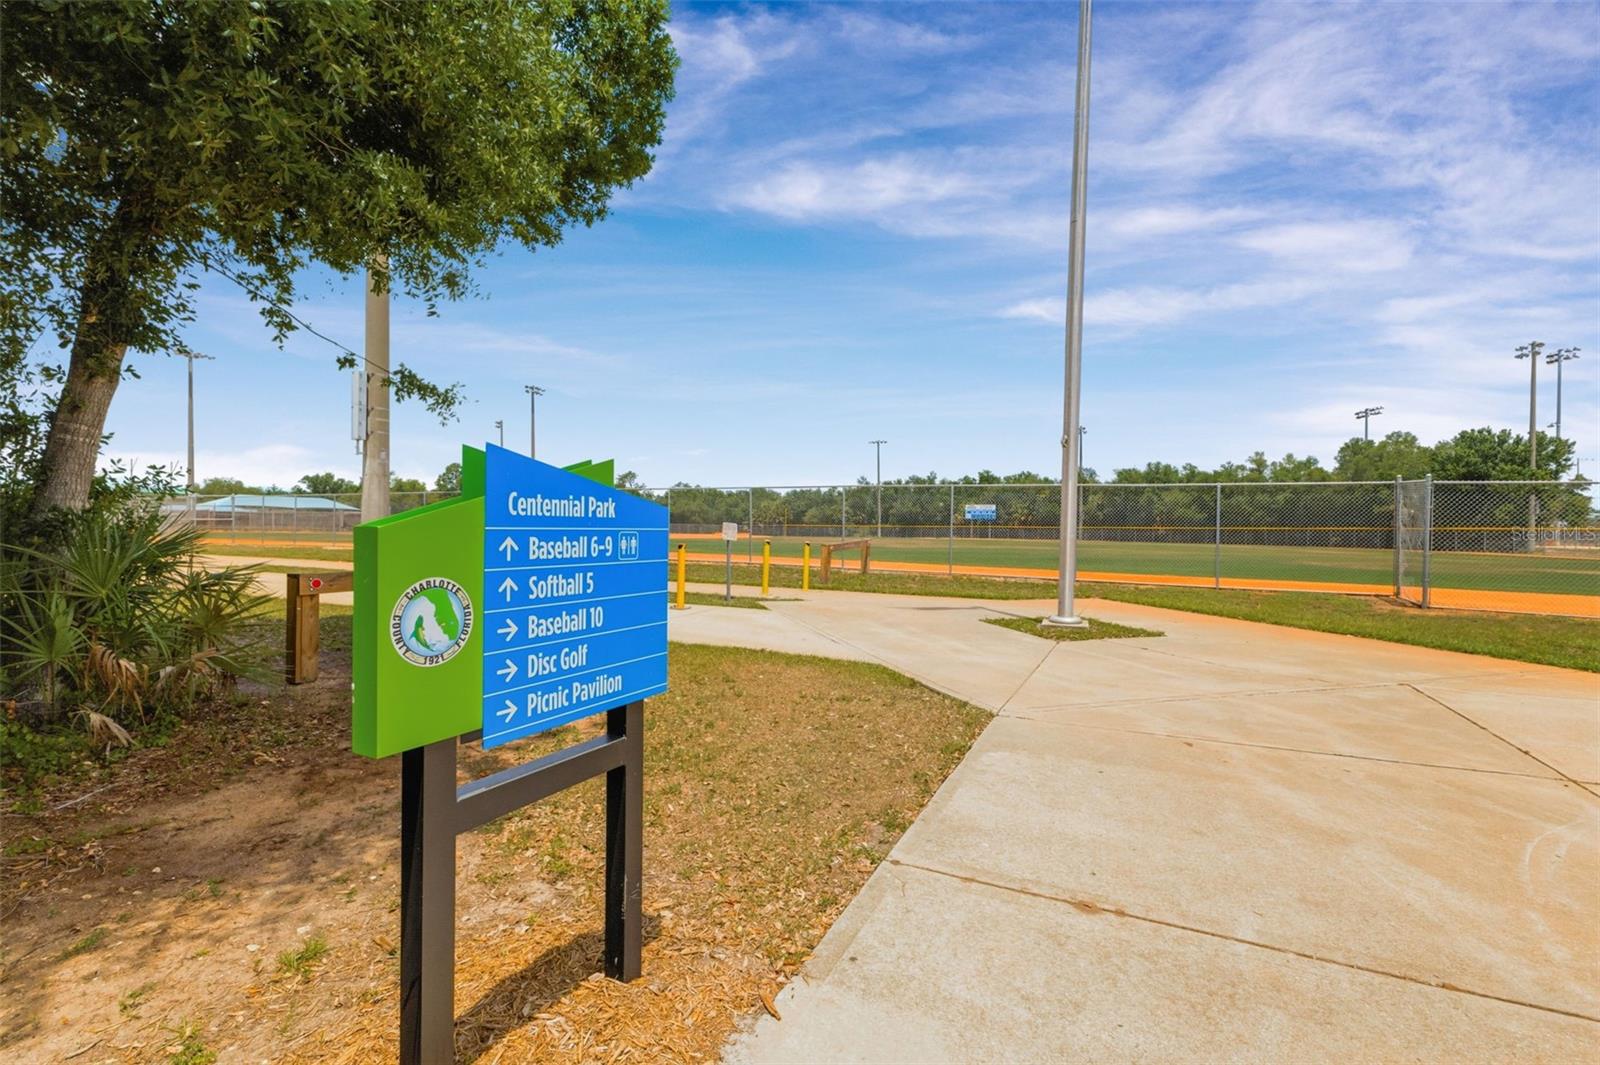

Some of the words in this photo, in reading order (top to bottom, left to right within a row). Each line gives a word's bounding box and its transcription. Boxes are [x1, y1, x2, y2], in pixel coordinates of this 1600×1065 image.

[508, 491, 585, 517] Centennial
[588, 496, 616, 518] Park
[528, 536, 588, 560] Baseball
[590, 536, 613, 557] 6-9
[405, 579, 462, 601] CHARLOTTE
[528, 572, 583, 599] Softball
[586, 572, 594, 593] 5
[392, 615, 411, 656] COUNTY
[455, 603, 472, 649] FLORIDA
[527, 608, 587, 639] Baseball
[590, 606, 604, 628] 10
[423, 654, 445, 665] 1921
[527, 652, 557, 679] Disc
[560, 643, 588, 670] Golf
[527, 686, 569, 717] Picnic
[572, 674, 622, 704] Pavilion
